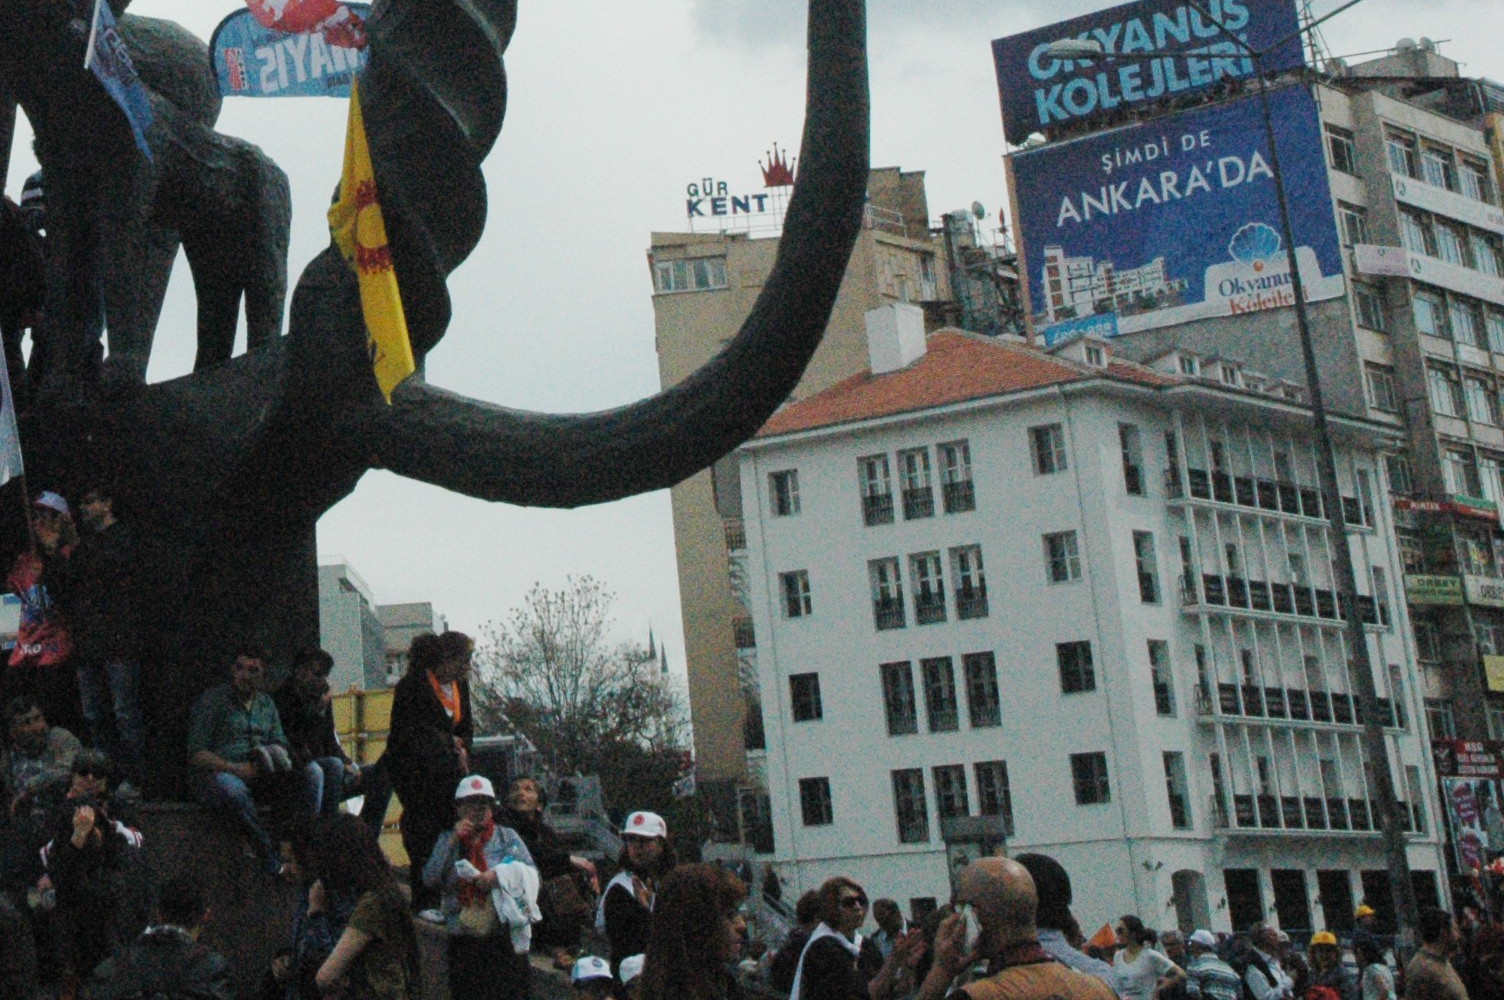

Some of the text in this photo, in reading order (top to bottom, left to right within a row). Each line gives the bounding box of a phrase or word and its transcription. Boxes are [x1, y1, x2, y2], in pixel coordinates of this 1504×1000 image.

[1033, 35, 1255, 125] KOLEJLERİ
[1101, 130, 1212, 174] ŞİMDİ DE
[686, 193, 769, 218] KENT
[687, 177, 728, 197] GÜR
[1056, 150, 1274, 228] ANKARA'DA
